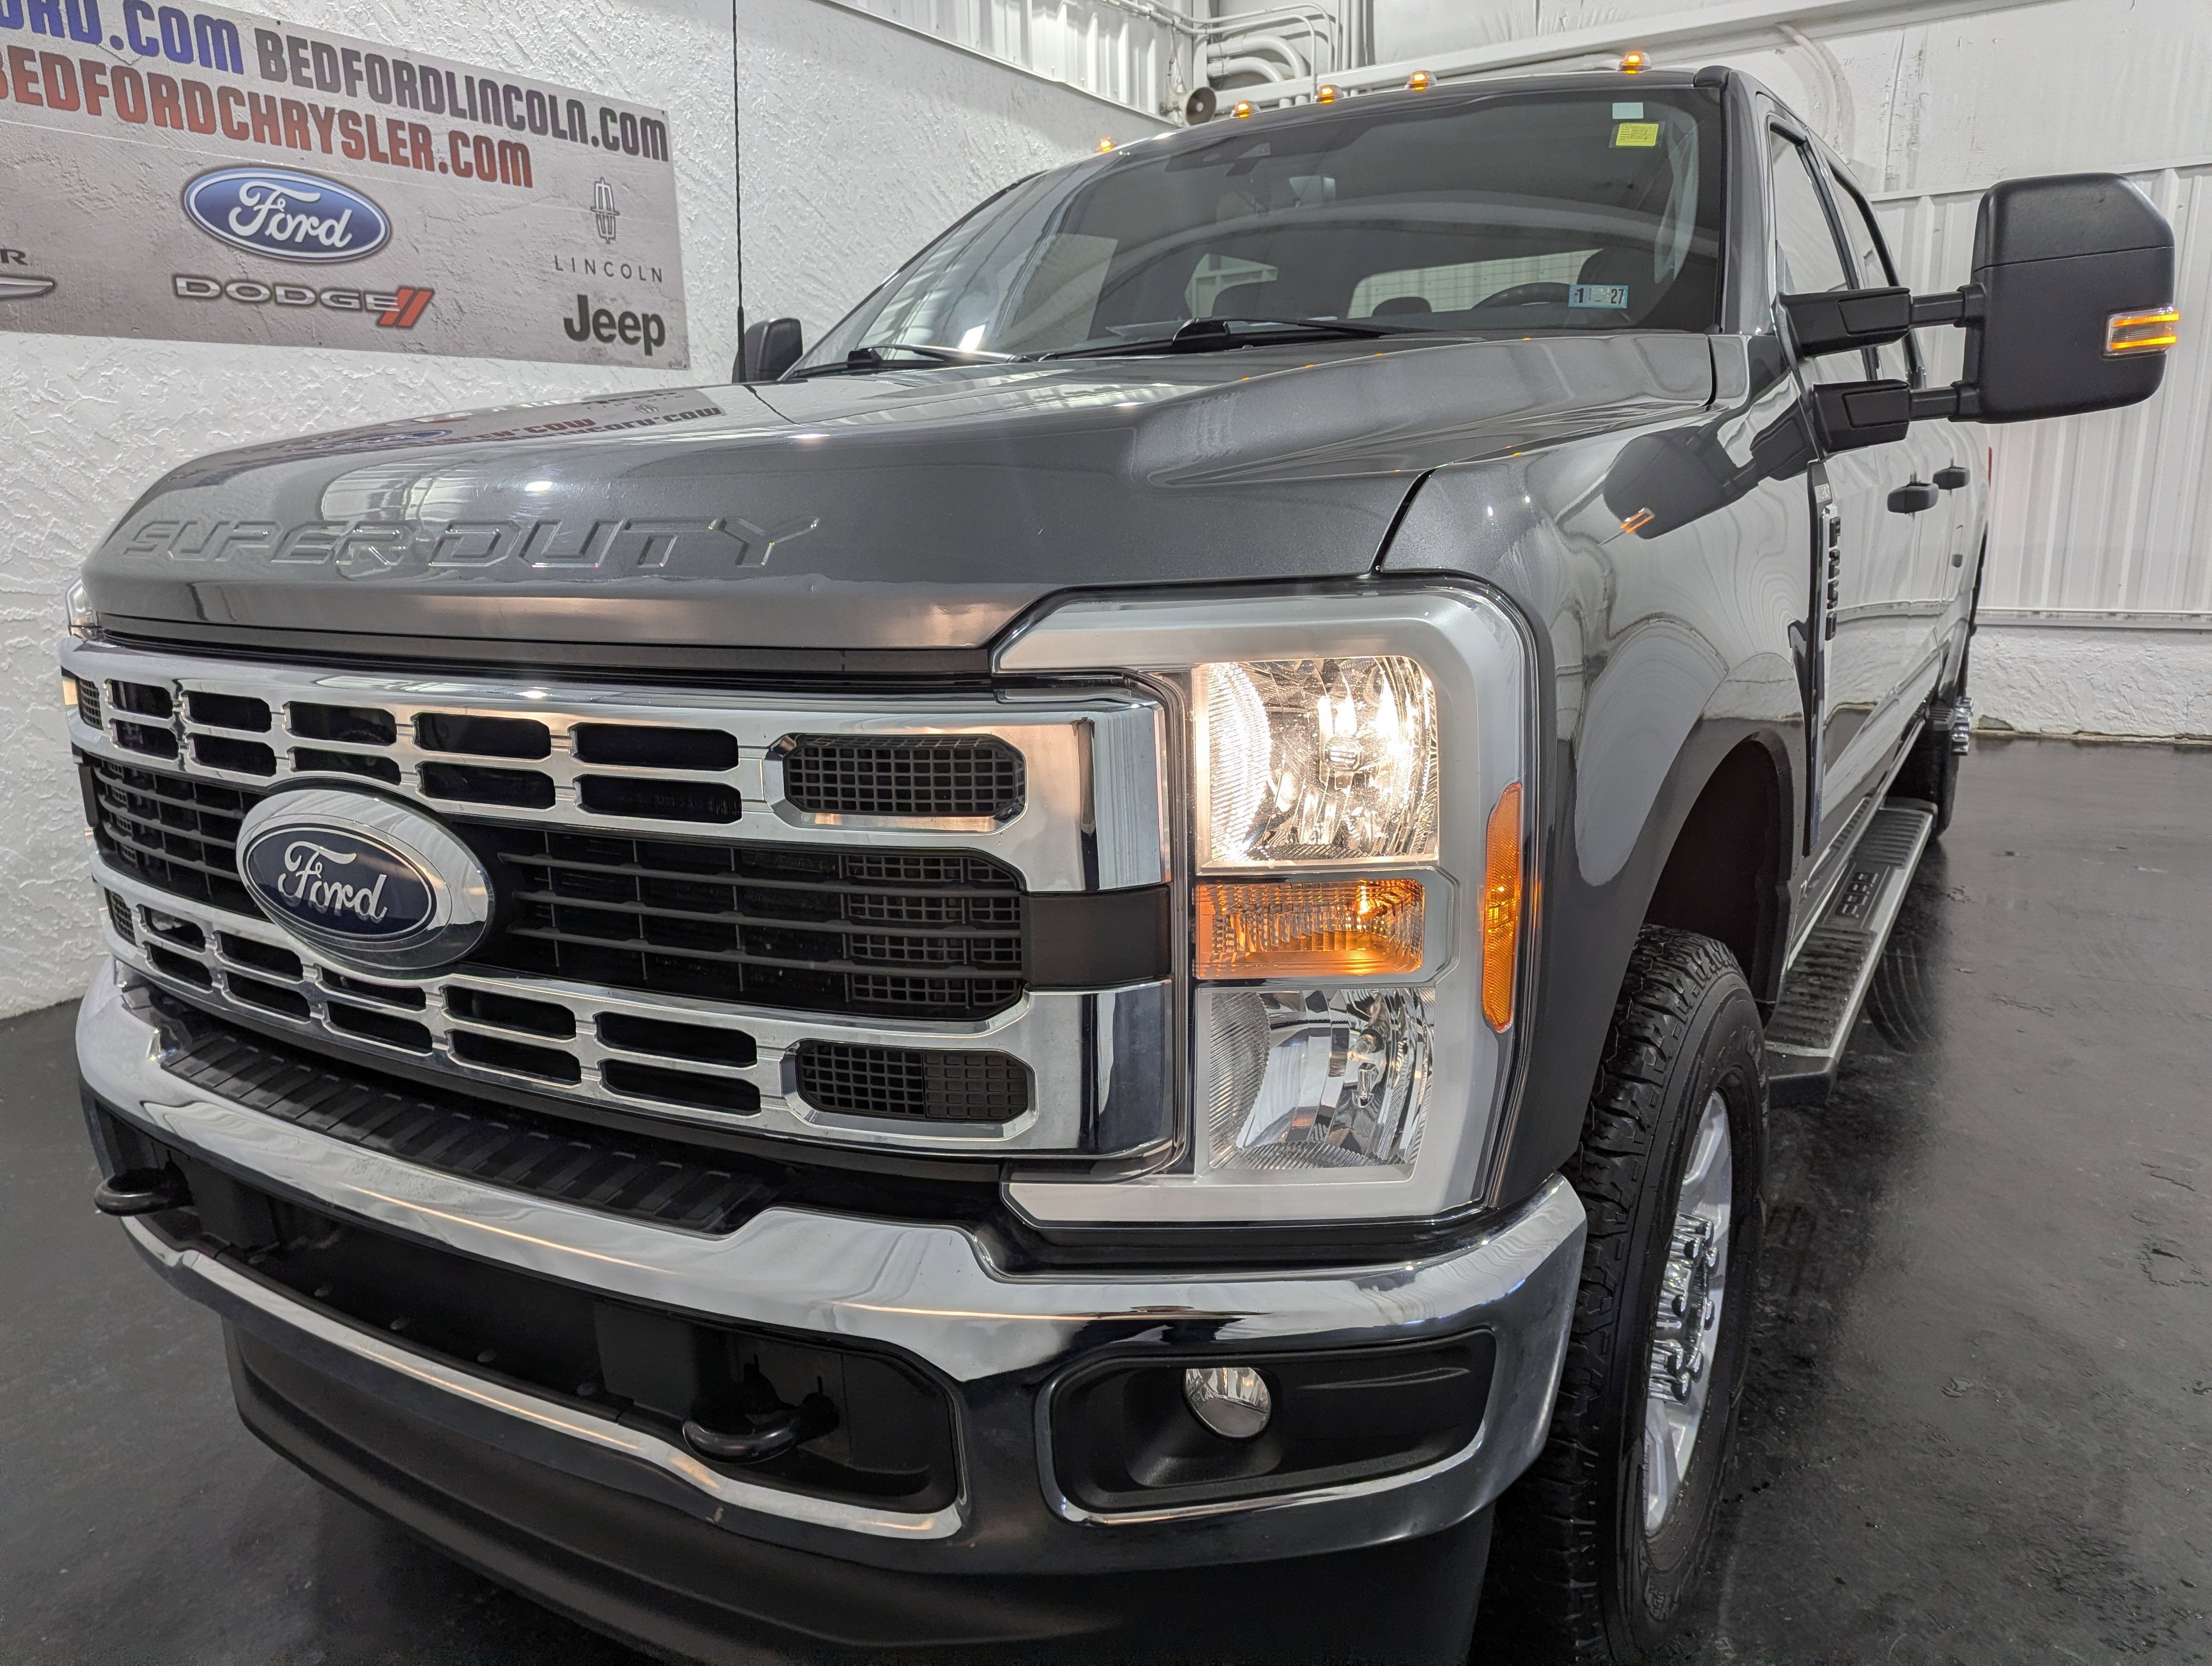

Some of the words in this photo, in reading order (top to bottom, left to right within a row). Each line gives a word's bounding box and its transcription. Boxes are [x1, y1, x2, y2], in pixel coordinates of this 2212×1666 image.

[0, 45, 533, 189] EDFORDCHRYSLER.COM
[254, 28, 669, 162] BEDFORDLINCOLN.COM
[228, 181, 353, 248] Ford
[173, 275, 400, 313] DODGE
[554, 255, 663, 283] LINCOLN
[1610, 288, 1625, 305] 27
[563, 293, 666, 356] Jeep
[123, 520, 416, 566] SUPER
[428, 516, 820, 568] DUTY
[277, 841, 388, 920] Ford
